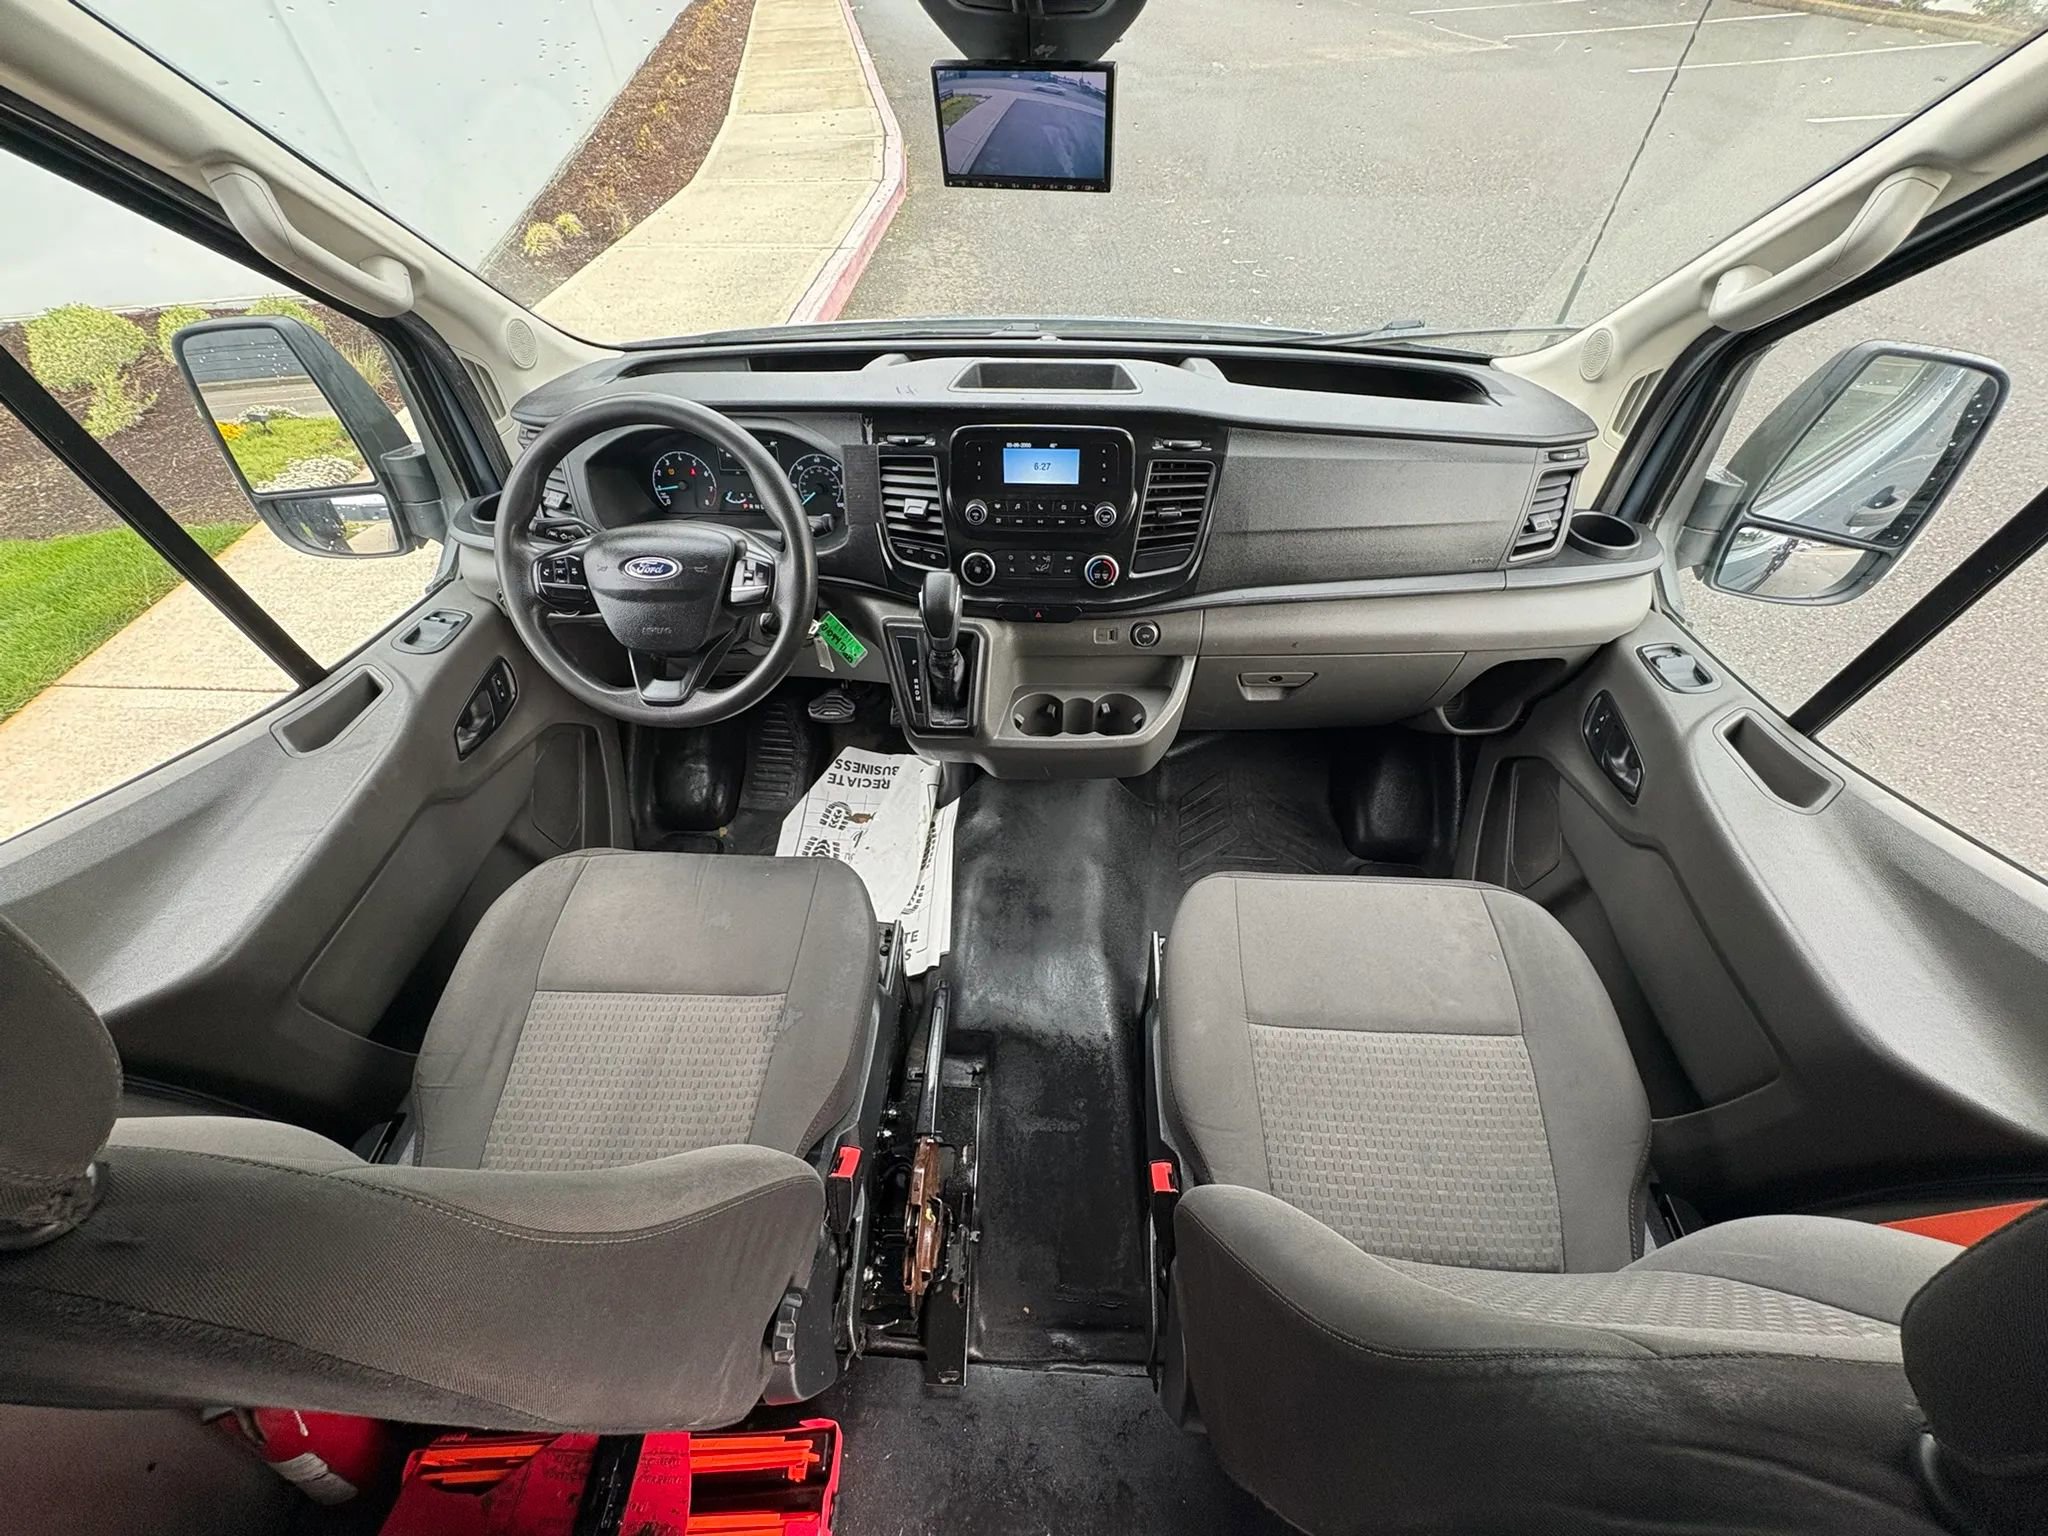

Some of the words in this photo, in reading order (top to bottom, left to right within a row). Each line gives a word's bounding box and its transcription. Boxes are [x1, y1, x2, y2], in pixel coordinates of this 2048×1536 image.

[1033, 462, 1051, 471] 6:27
[636, 560, 665, 574] Ford
[827, 773, 890, 790] RECIATE
